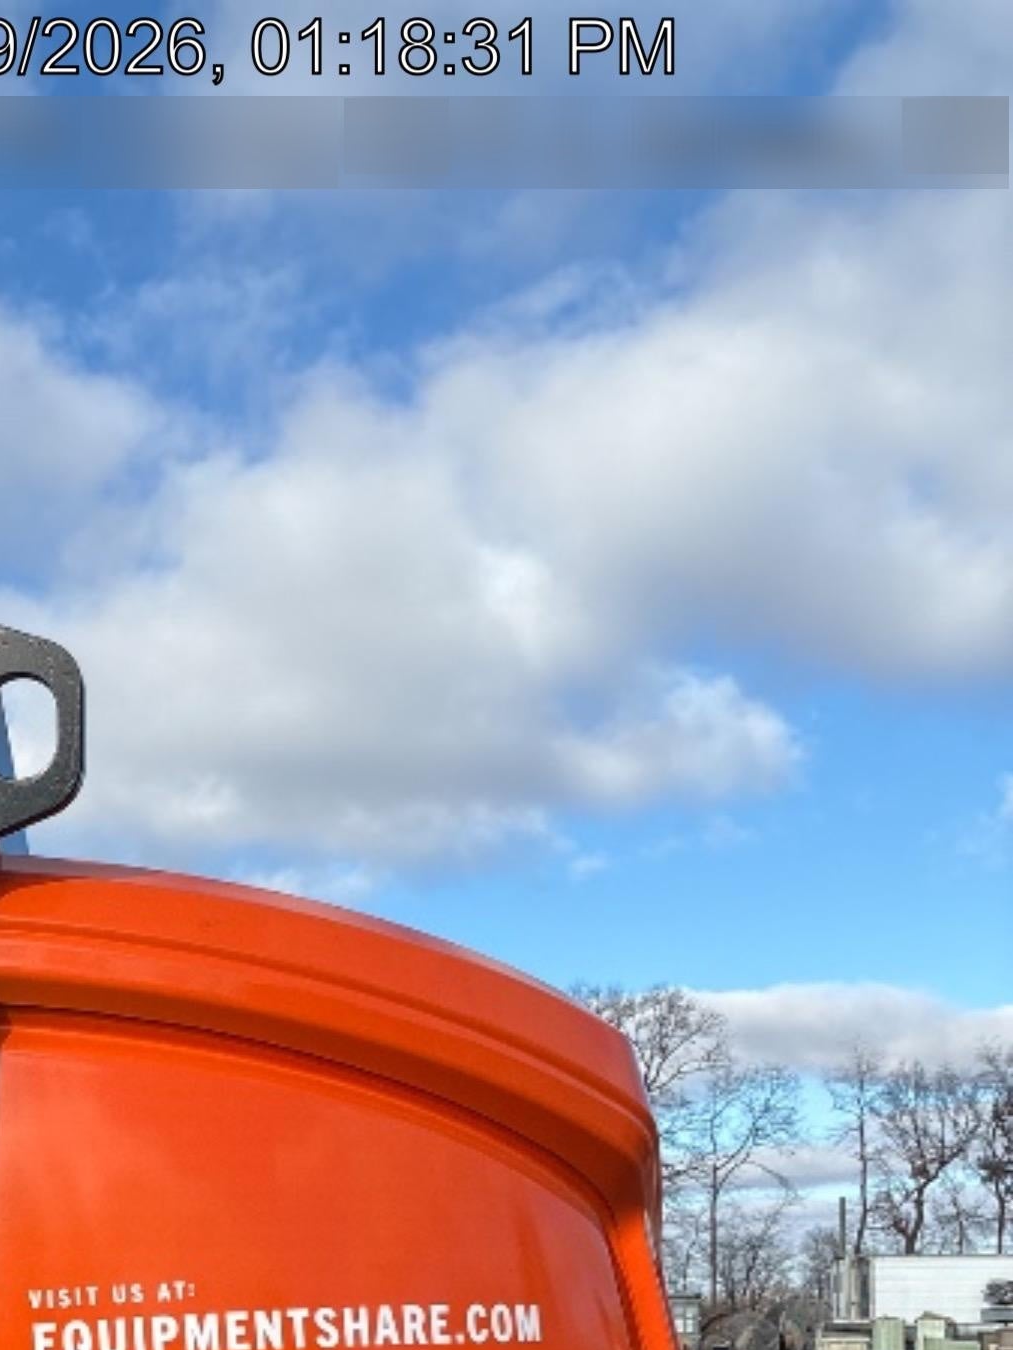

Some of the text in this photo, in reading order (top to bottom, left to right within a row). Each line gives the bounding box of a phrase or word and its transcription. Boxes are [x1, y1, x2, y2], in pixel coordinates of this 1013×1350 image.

[28, 1281, 195, 1308] VISIT US AT:
